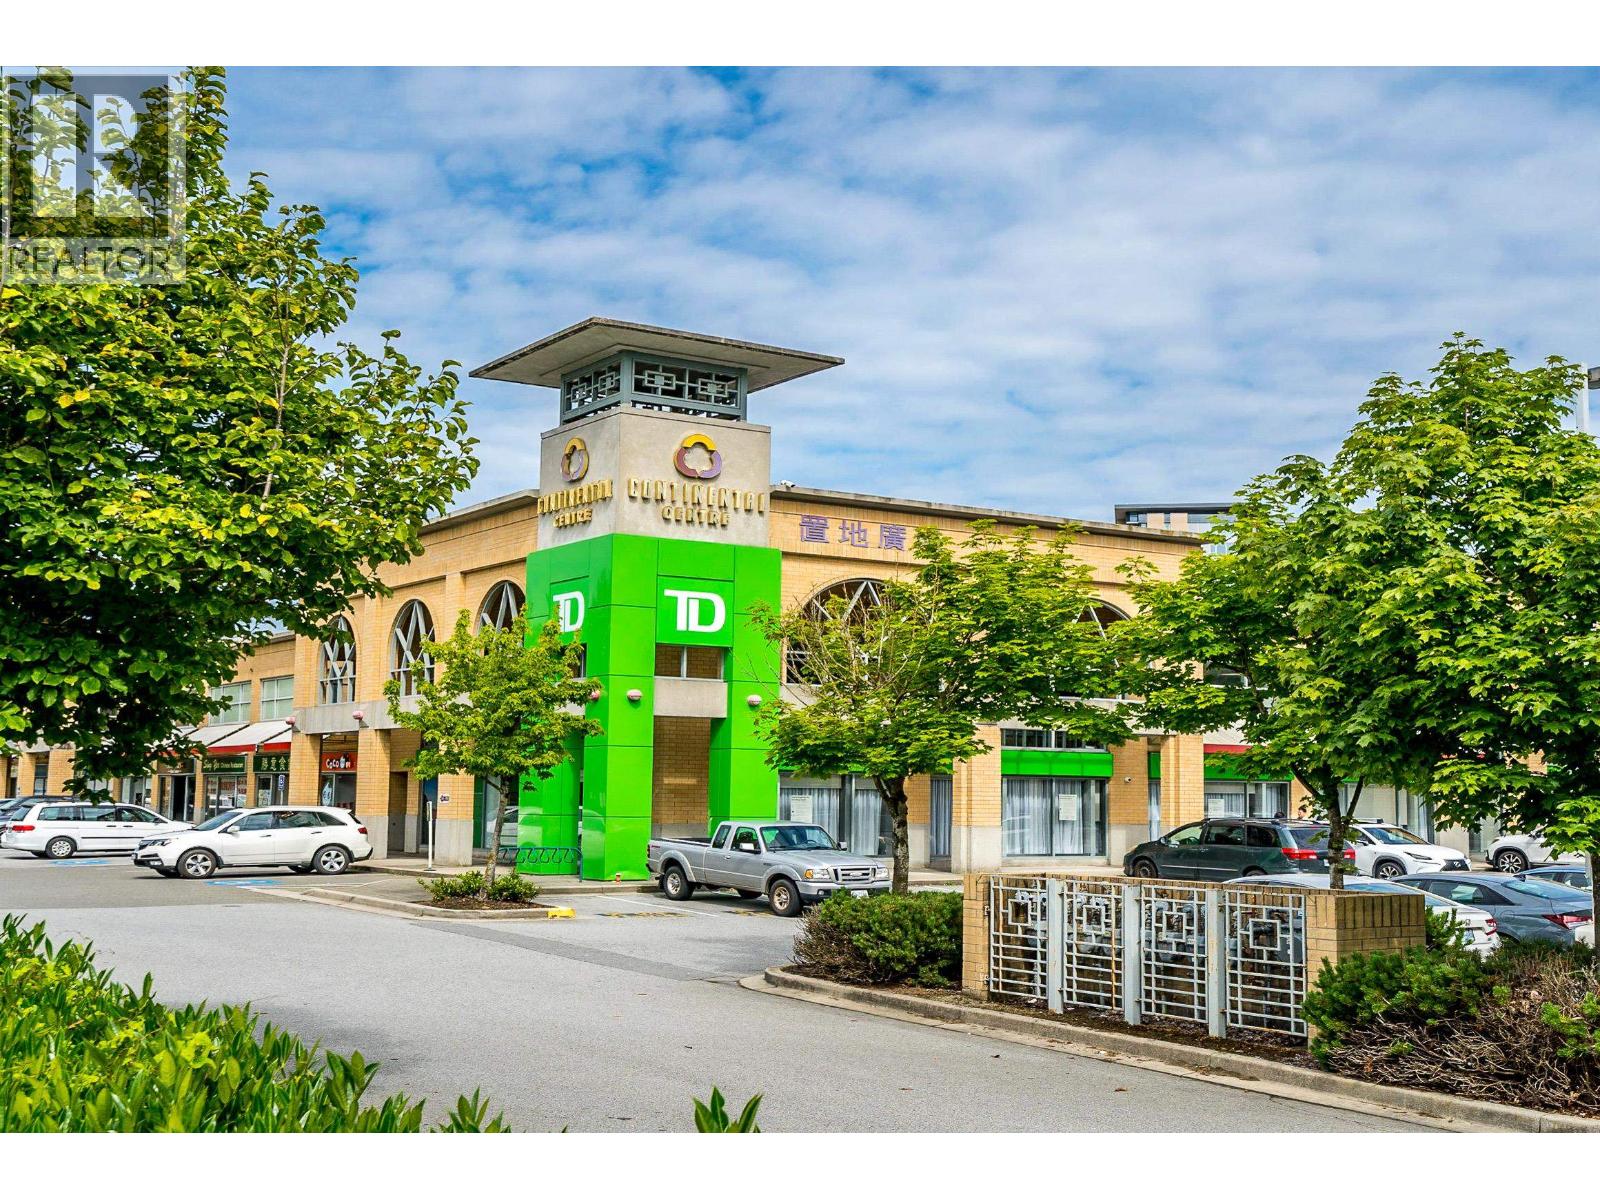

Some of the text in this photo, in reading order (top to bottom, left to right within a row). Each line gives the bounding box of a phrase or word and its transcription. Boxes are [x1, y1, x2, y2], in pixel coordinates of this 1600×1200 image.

[628, 477, 766, 513] CONTINENTAL
[553, 508, 592, 528] CENTRE
[662, 505, 732, 526] CENTRE
[552, 590, 586, 633] TD
[663, 589, 727, 633] TD
